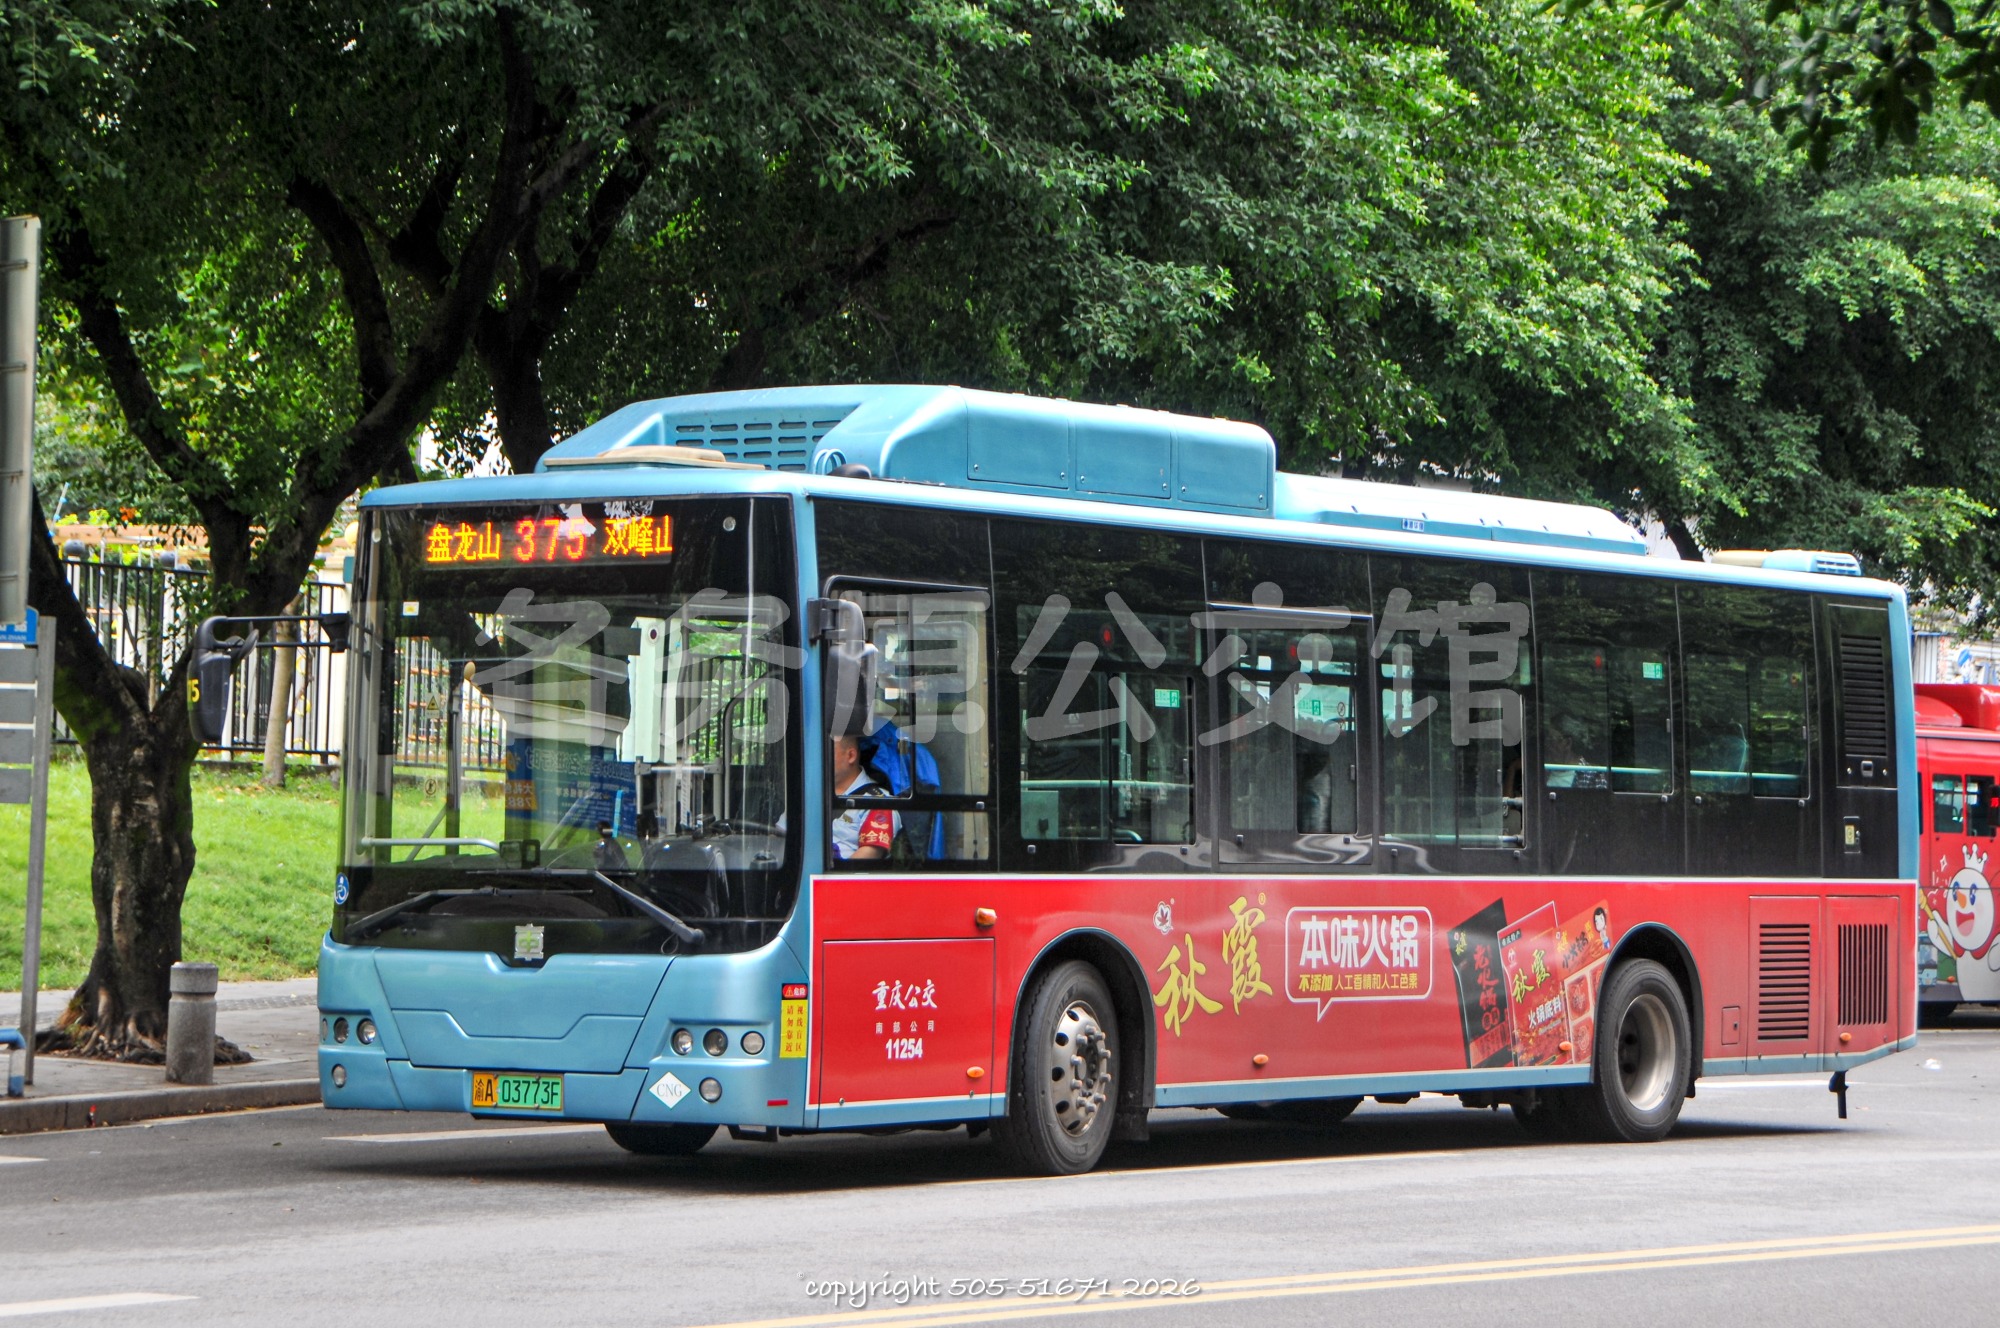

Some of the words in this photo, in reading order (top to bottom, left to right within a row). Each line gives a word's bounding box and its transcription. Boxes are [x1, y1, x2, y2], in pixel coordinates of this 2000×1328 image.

[428, 522, 500, 562] 盘龙山
[517, 519, 586, 561] 375
[1299, 915, 1418, 969] 本味火锅
[1153, 896, 1273, 1038] 秋霞
[872, 979, 937, 1010] 重庆公交
[876, 1020, 934, 1034] 南部公司
[1528, 995, 1562, 1028] 火锅底料
[886, 1038, 923, 1059] 11254
[656, 1083, 682, 1097] CNG
